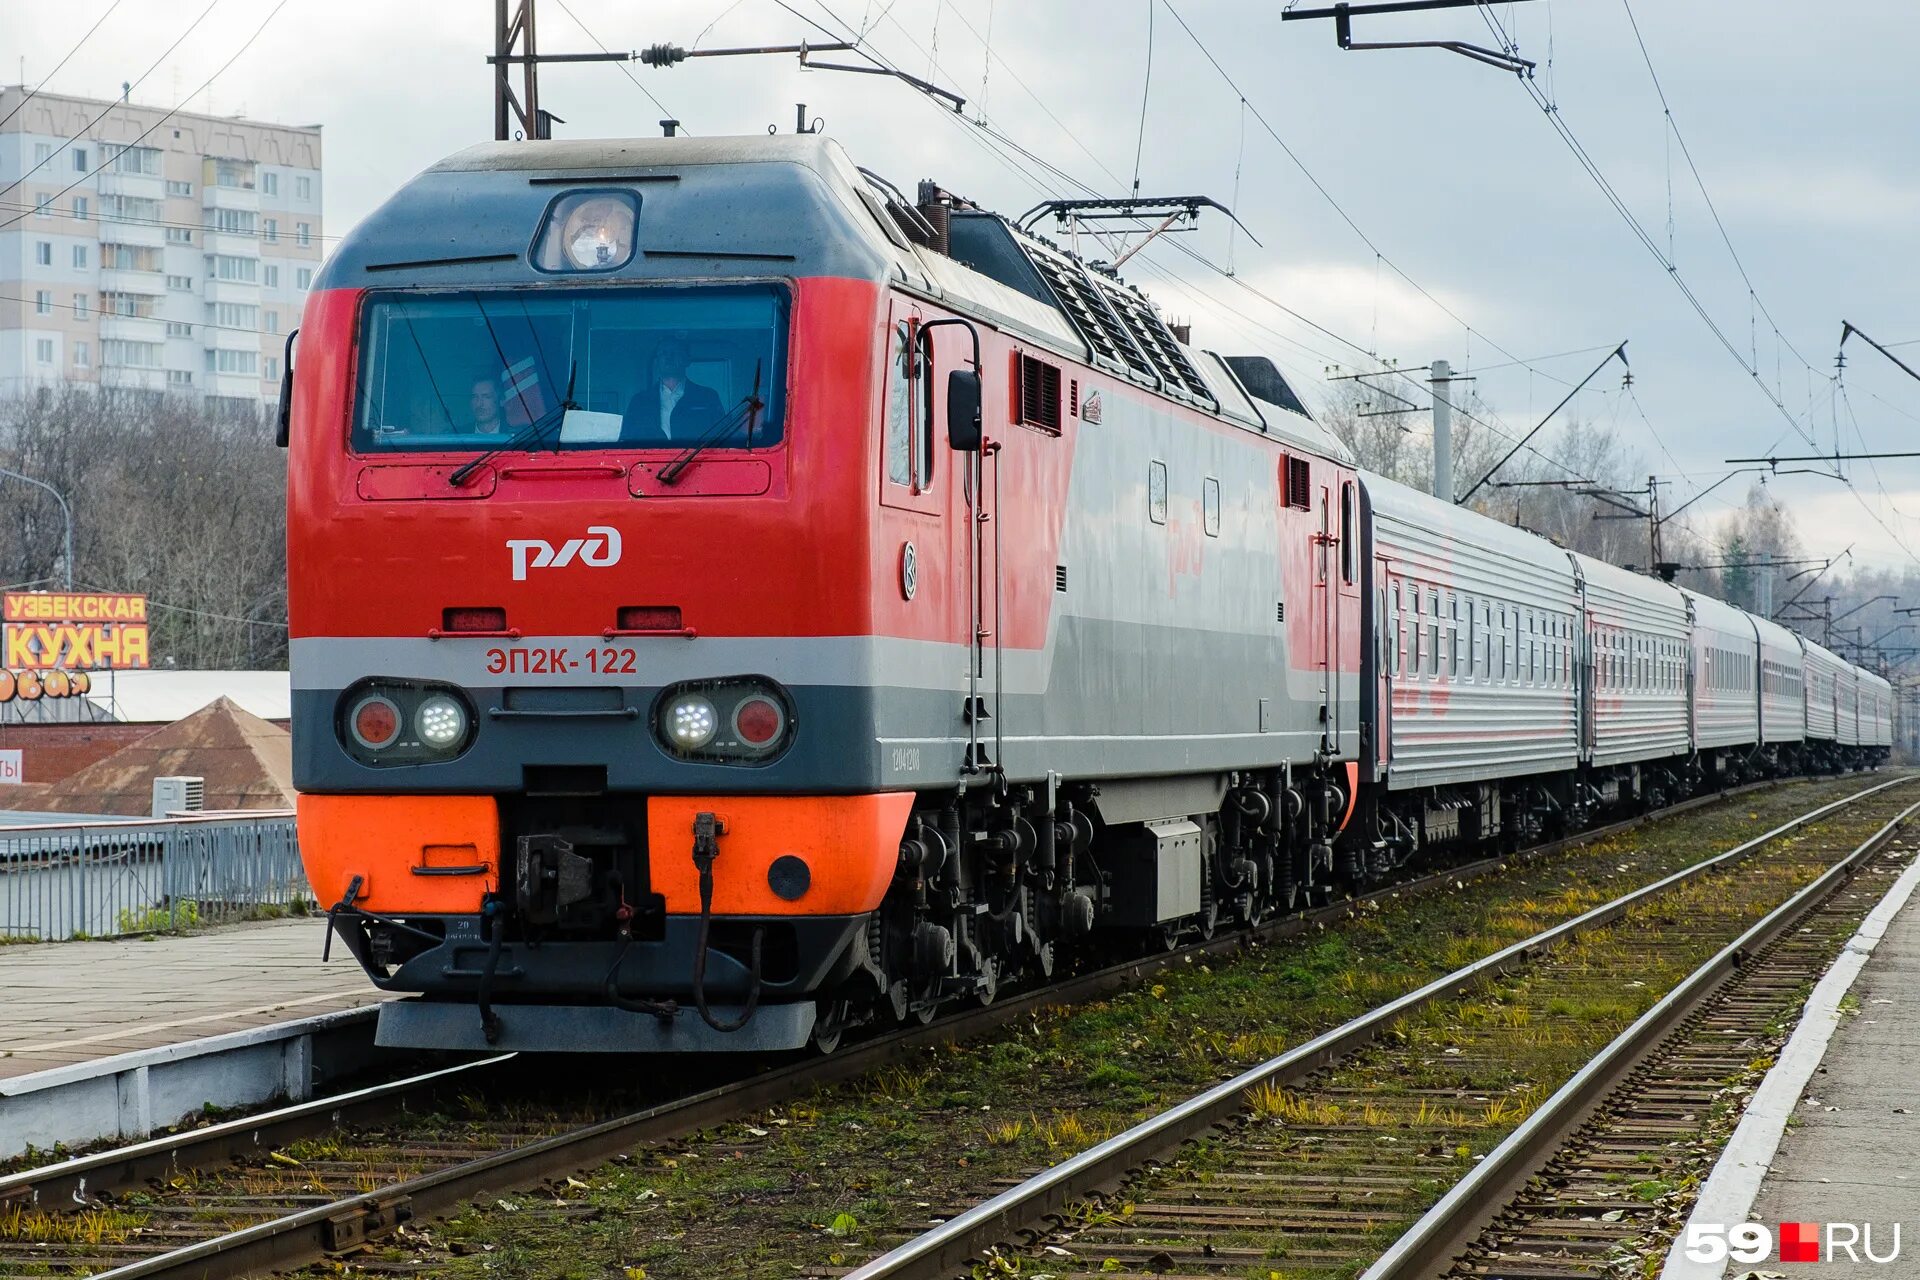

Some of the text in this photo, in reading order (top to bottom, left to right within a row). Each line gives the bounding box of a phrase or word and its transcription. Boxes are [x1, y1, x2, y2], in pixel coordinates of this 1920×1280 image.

[9, 596, 146, 618] УЗБЕКСКАЯ
[8, 626, 149, 667] КУХНЯ
[486, 648, 637, 674] ЭП2К-122
